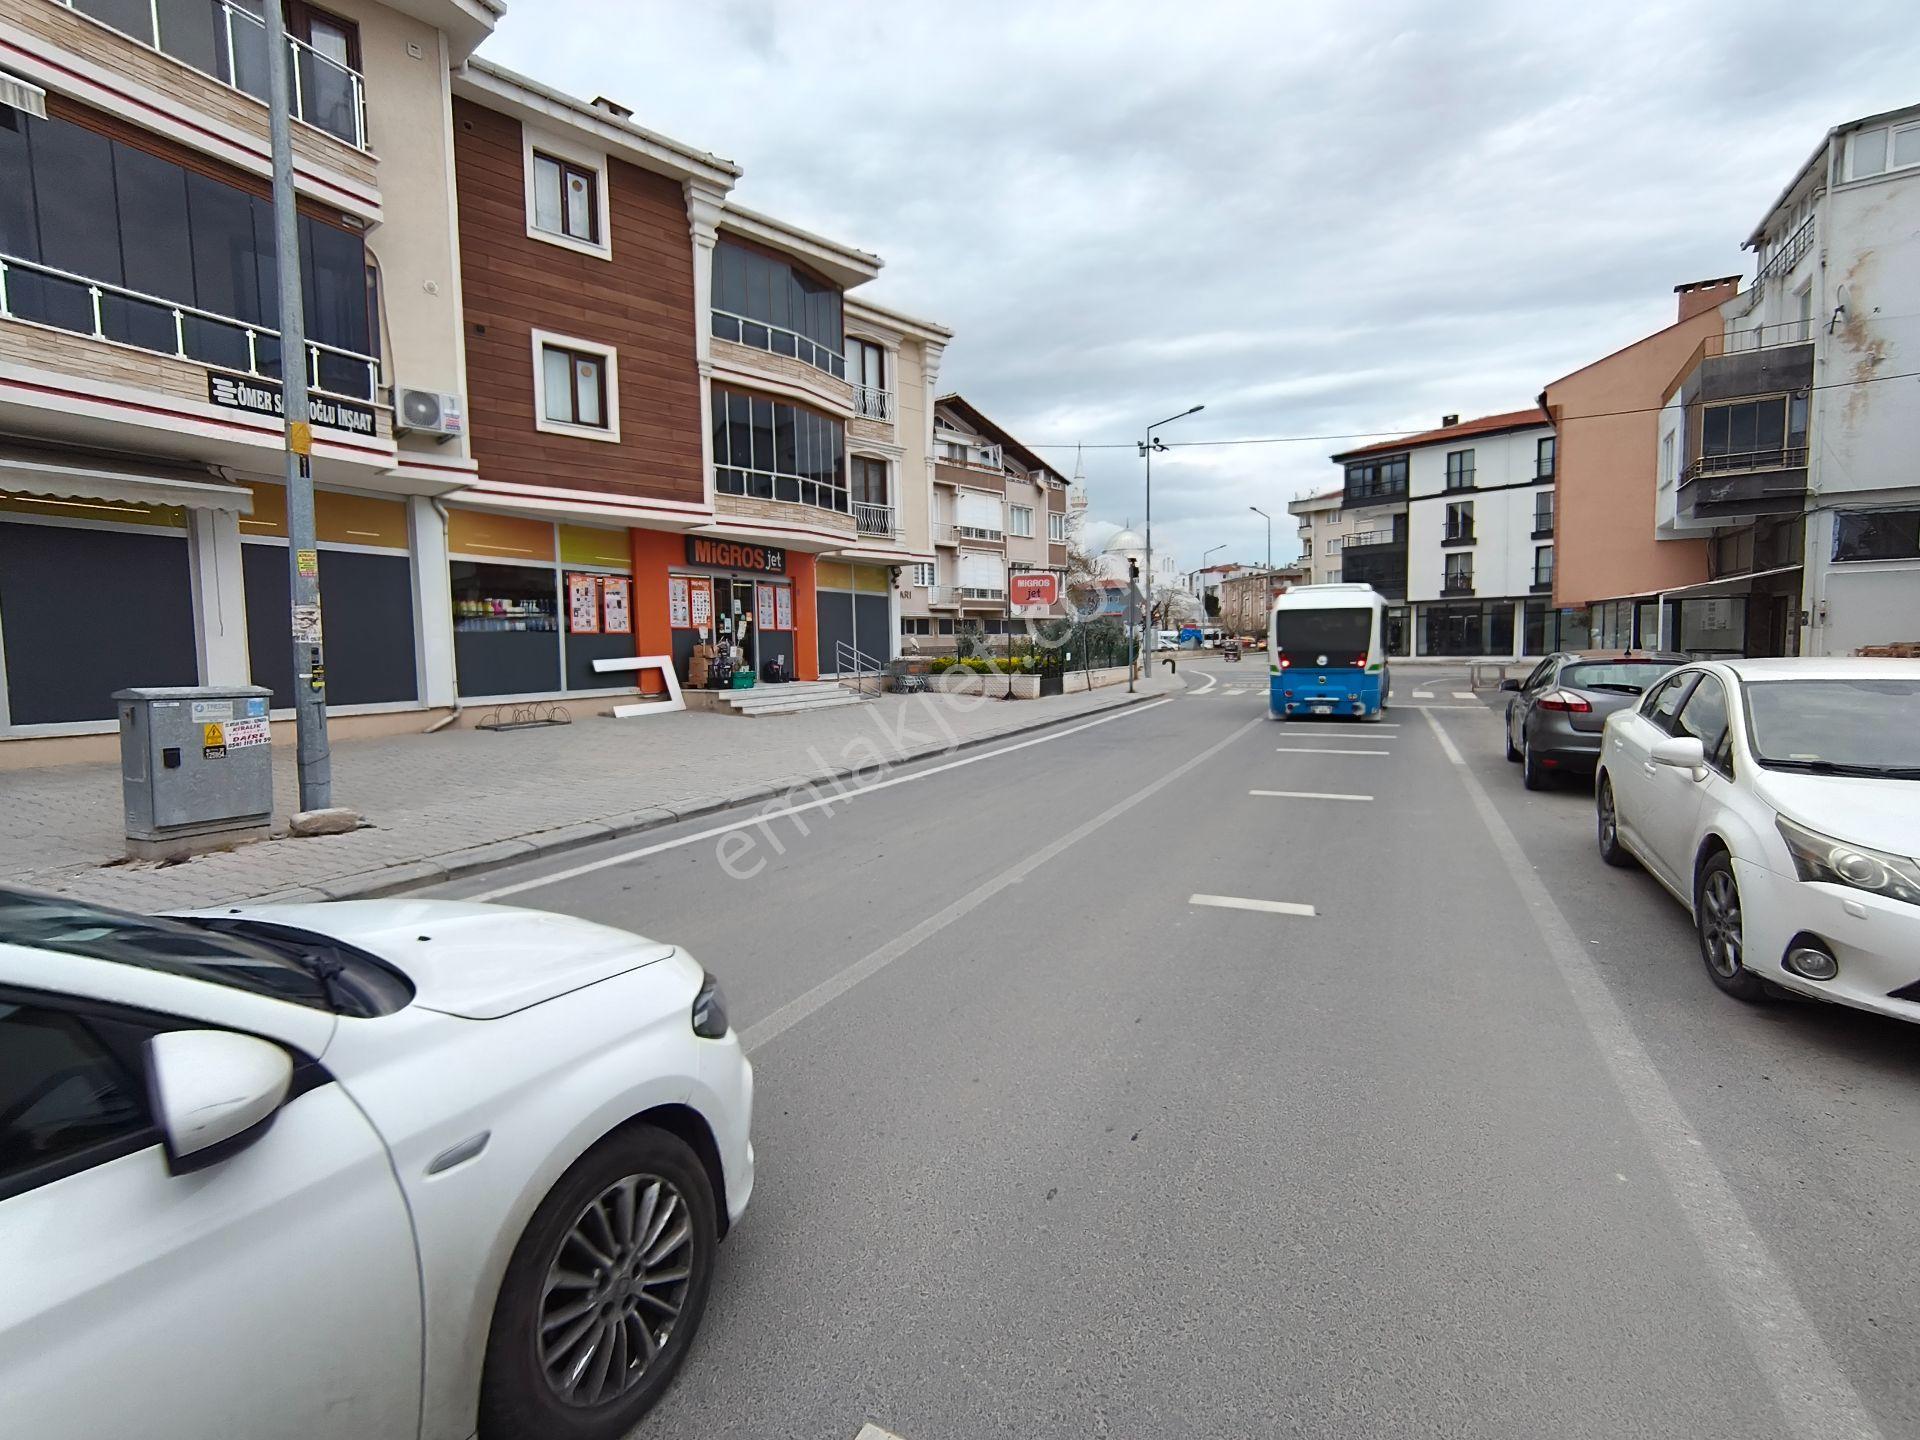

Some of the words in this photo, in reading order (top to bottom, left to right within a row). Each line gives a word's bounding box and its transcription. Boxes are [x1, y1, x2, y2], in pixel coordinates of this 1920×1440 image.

[237, 381, 272, 411] ÖMER
[338, 404, 372, 432] İNŞAAT
[765, 550, 781, 570] jet
[1026, 588, 1040, 600] jet
